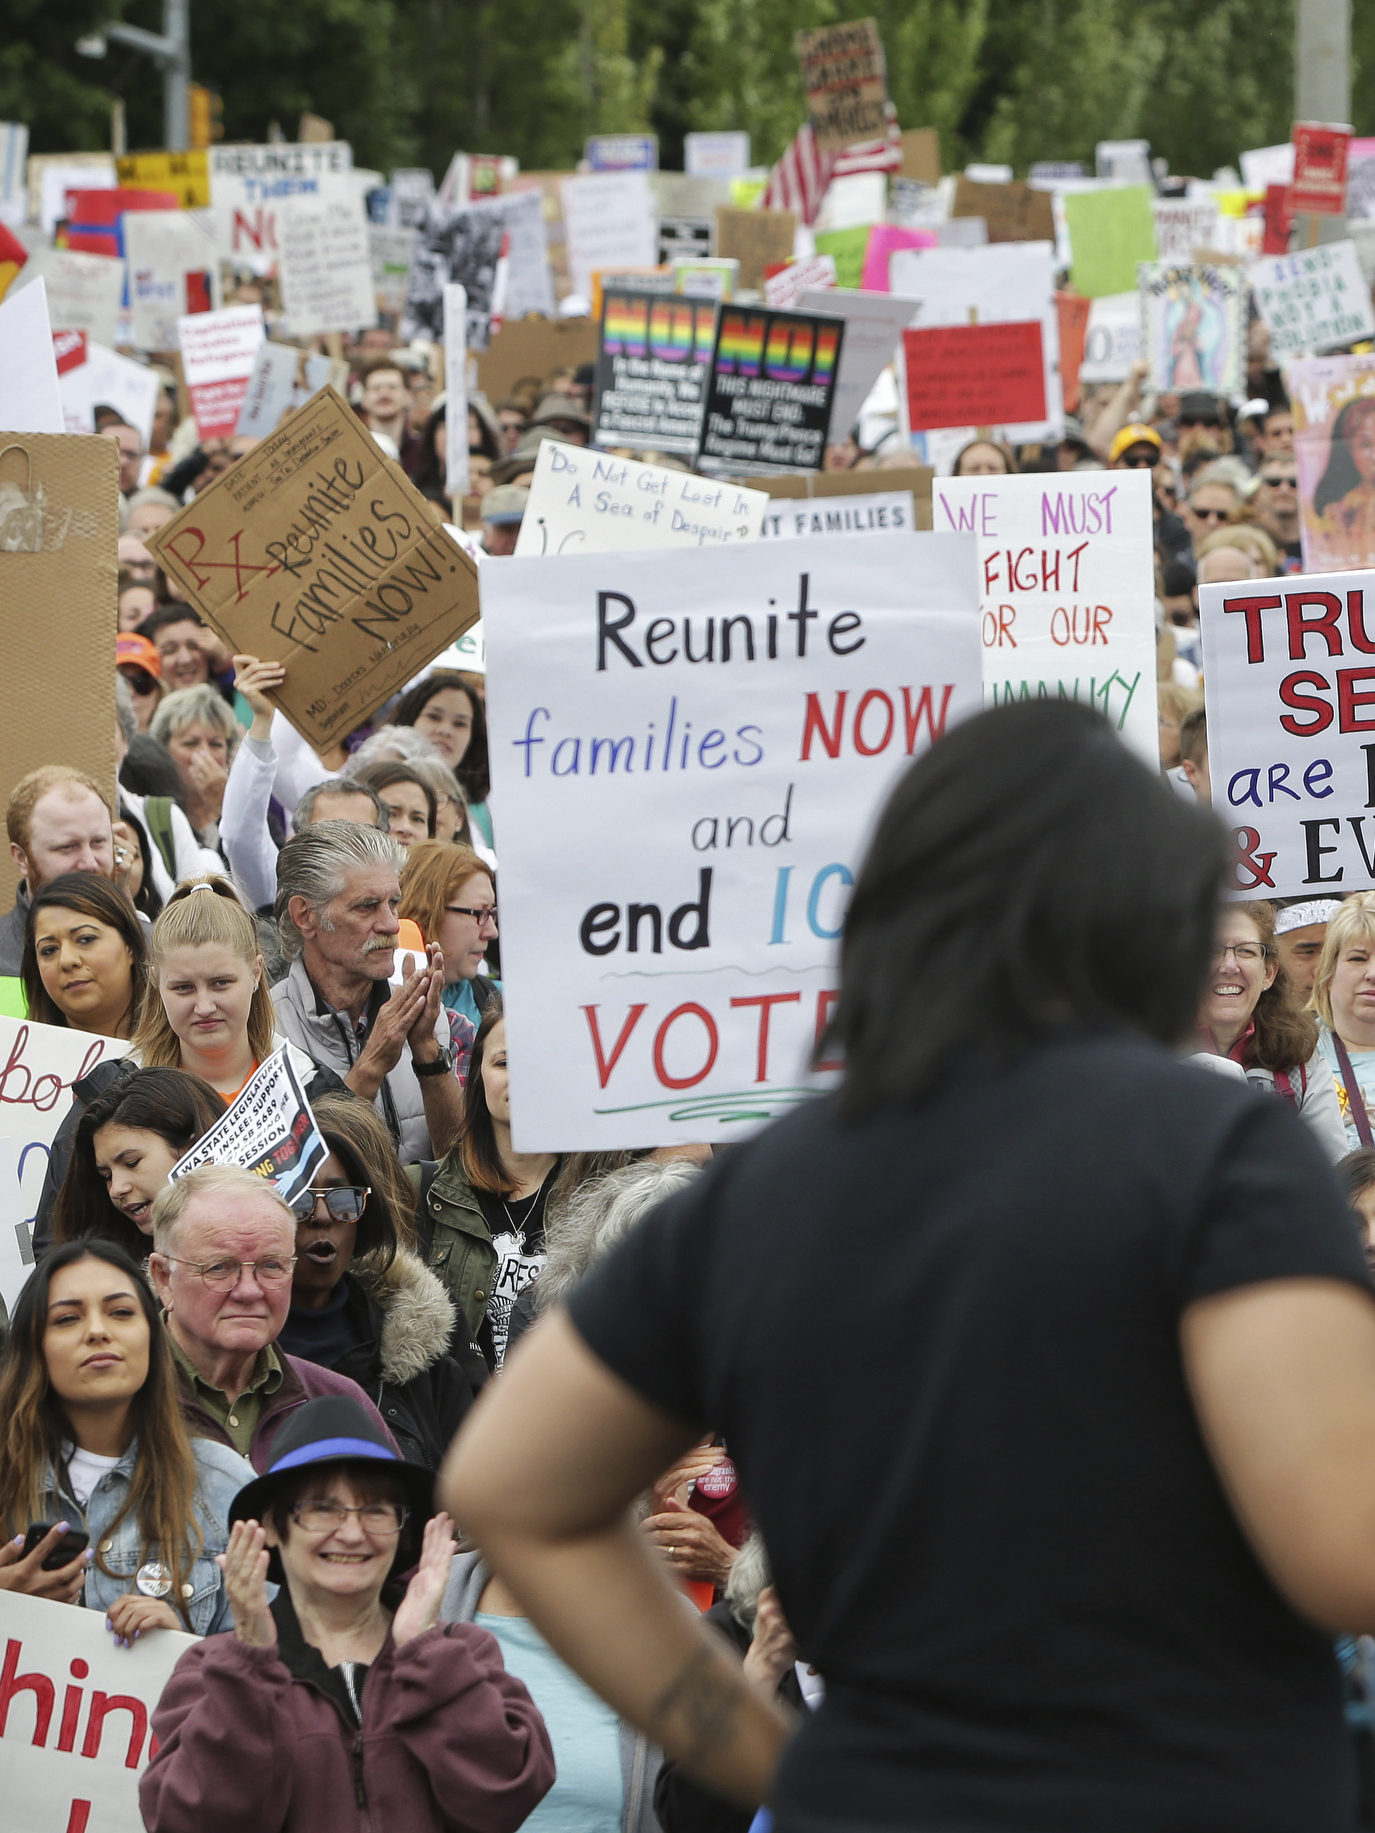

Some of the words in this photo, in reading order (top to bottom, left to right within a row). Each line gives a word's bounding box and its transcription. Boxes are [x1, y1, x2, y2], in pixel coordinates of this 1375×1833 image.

[717, 314, 838, 386] NO!
[716, 373, 748, 396] THIS
[731, 397, 770, 420] MUST
[567, 484, 583, 507] A
[593, 490, 633, 518] Sea
[643, 500, 665, 525] of
[593, 459, 629, 489] Not
[637, 469, 669, 497] Get
[680, 479, 724, 508] Lost
[733, 493, 750, 516] In
[939, 492, 998, 536] WE
[1041, 486, 1118, 536] MUST
[264, 456, 365, 578] Reunite
[797, 504, 905, 535] FAMILIES
[270, 498, 412, 652] Families
[351, 525, 457, 642] NOW!
[984, 541, 1089, 595] FIGHT
[595, 571, 868, 671] Reunite
[980, 604, 1018, 648] OR
[1051, 604, 1113, 647] OUR
[512, 696, 765, 778] families
[799, 682, 955, 762] NOW
[1226, 757, 1335, 807] are
[691, 782, 794, 852] and
[1230, 825, 1278, 891] &
[579, 866, 714, 957] end
[767, 862, 855, 946] IC
[182, 1155, 202, 1175] WA
[202, 1126, 230, 1159] STATE
[229, 1056, 280, 1126] LEGISLATURE
[218, 1115, 253, 1156] INSLEE:
[252, 1063, 285, 1117] SUPPORT
[255, 1098, 278, 1130] 5689
[238, 1123, 287, 1166] SESSION
[697, 1476, 710, 1484] are
[710, 1476, 722, 1484] not
[703, 1483, 730, 1493] enemy
